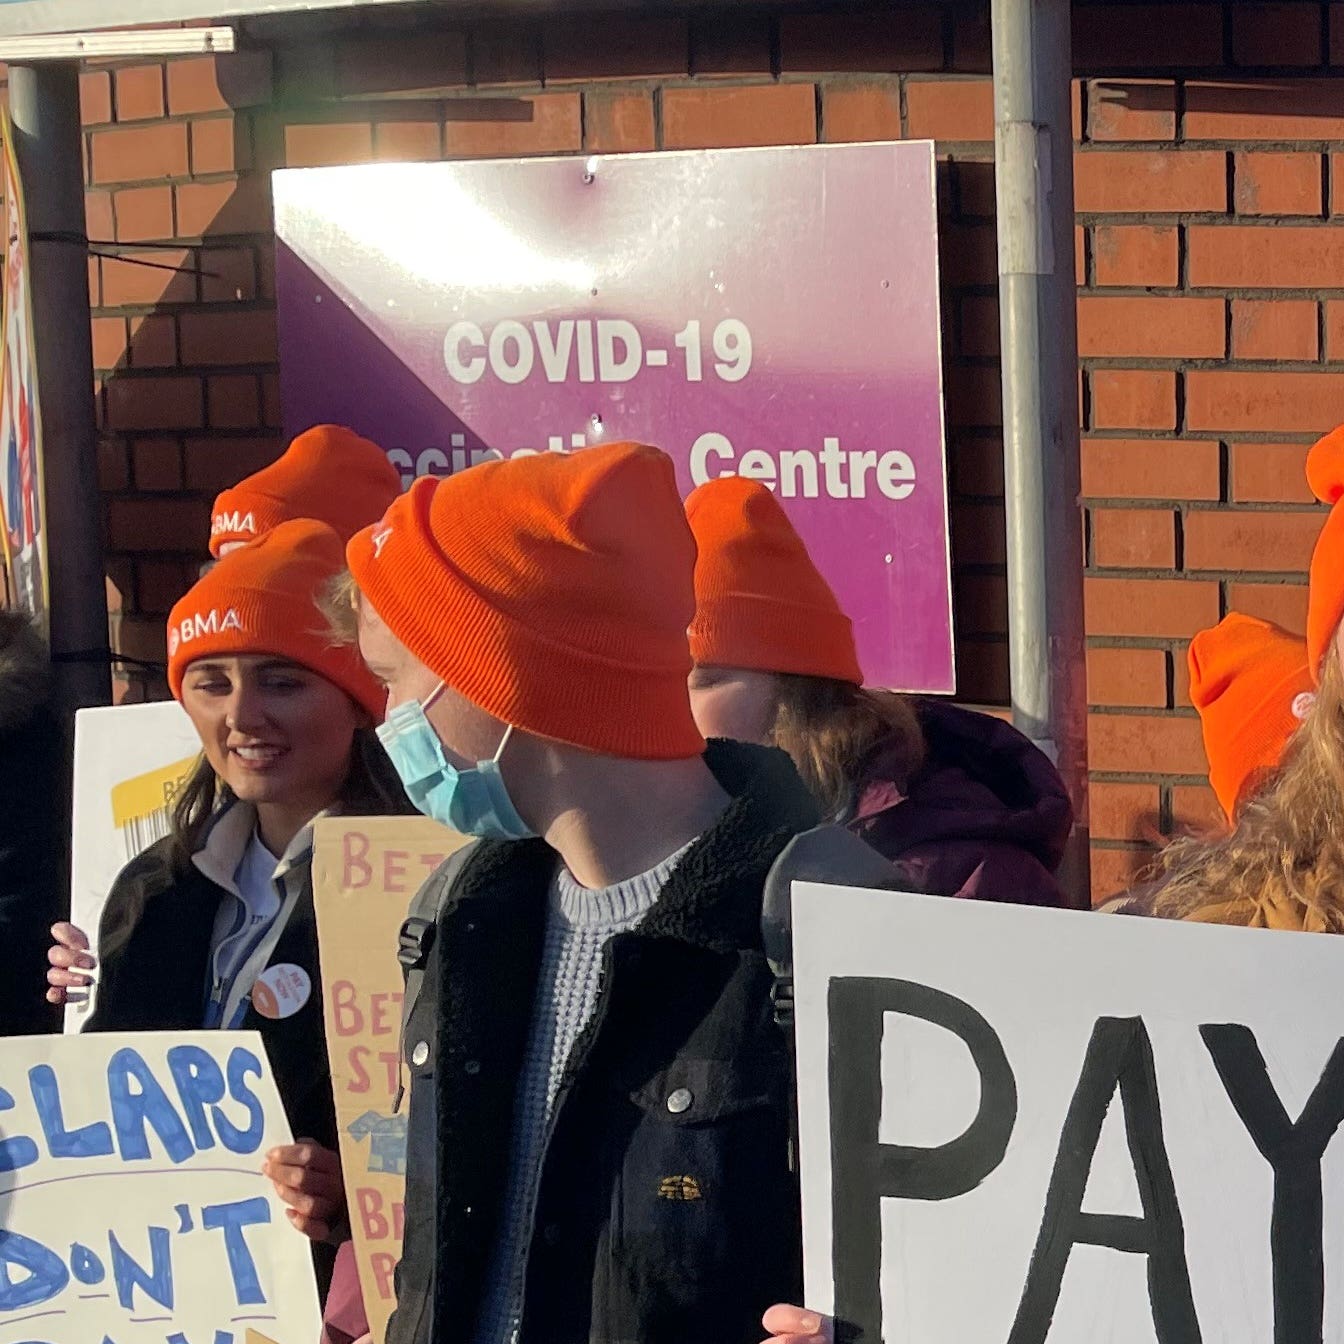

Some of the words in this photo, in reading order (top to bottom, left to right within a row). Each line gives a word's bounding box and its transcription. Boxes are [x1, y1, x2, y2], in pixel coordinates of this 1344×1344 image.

[443, 317, 752, 385] COVID-19
[690, 431, 916, 500] Centre
[181, 608, 244, 644] BMA
